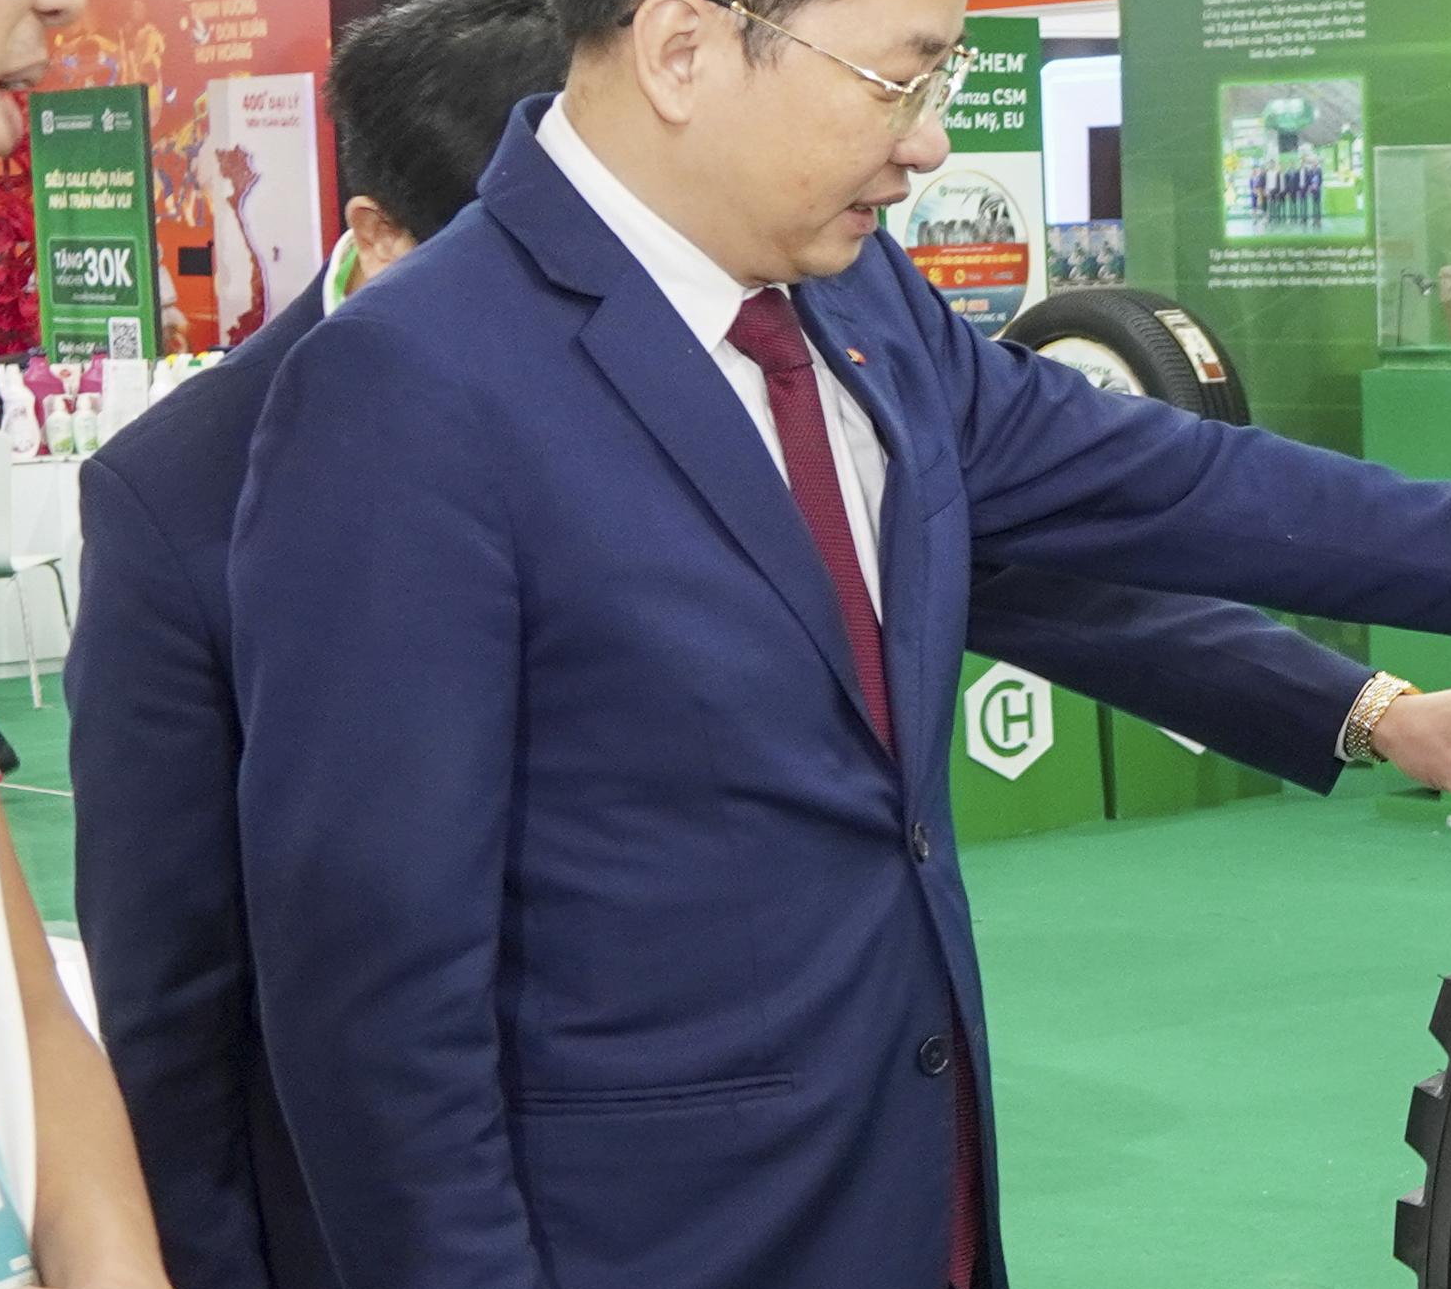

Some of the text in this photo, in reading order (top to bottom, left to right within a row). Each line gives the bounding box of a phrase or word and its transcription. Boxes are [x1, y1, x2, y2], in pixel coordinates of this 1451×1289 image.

[993, 88, 1027, 105] CSM
[1003, 112, 1024, 128] EU
[84, 247, 133, 287] 30K
